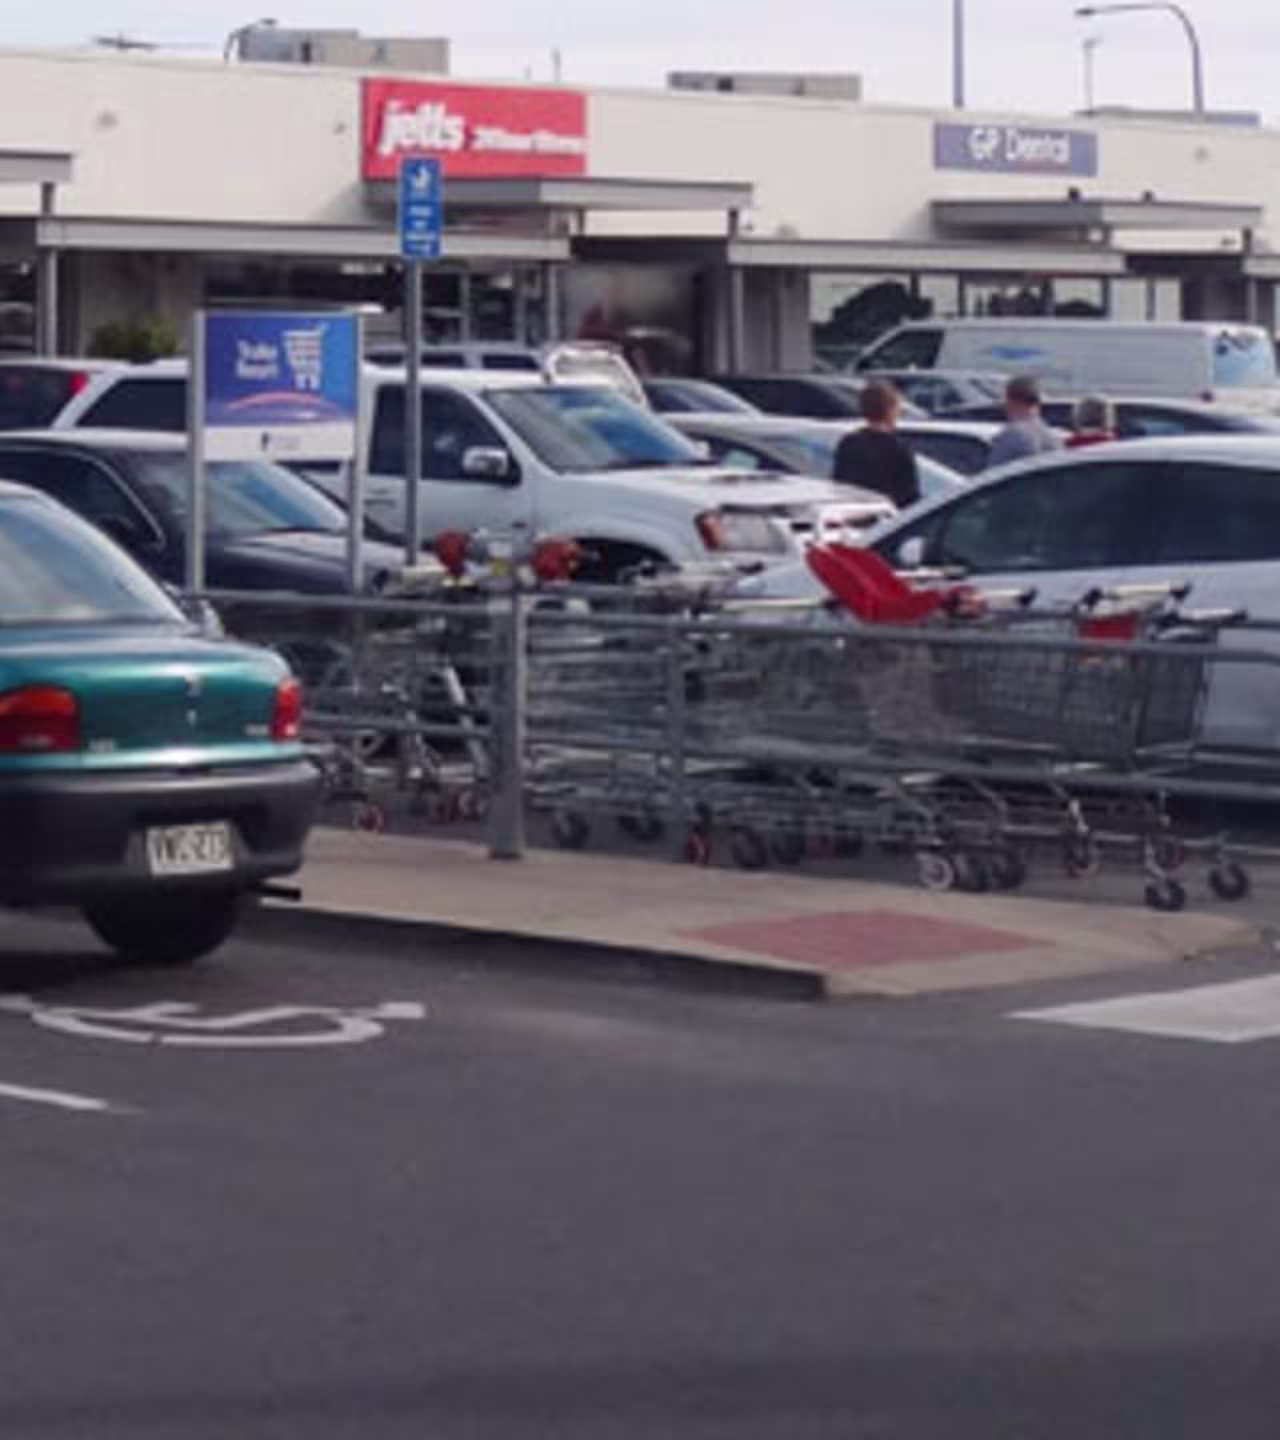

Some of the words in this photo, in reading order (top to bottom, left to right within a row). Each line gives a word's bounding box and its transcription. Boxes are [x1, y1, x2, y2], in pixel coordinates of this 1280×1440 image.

[378, 98, 466, 157] jetts
[967, 126, 999, 160] GP
[1005, 126, 1072, 164] Dental
